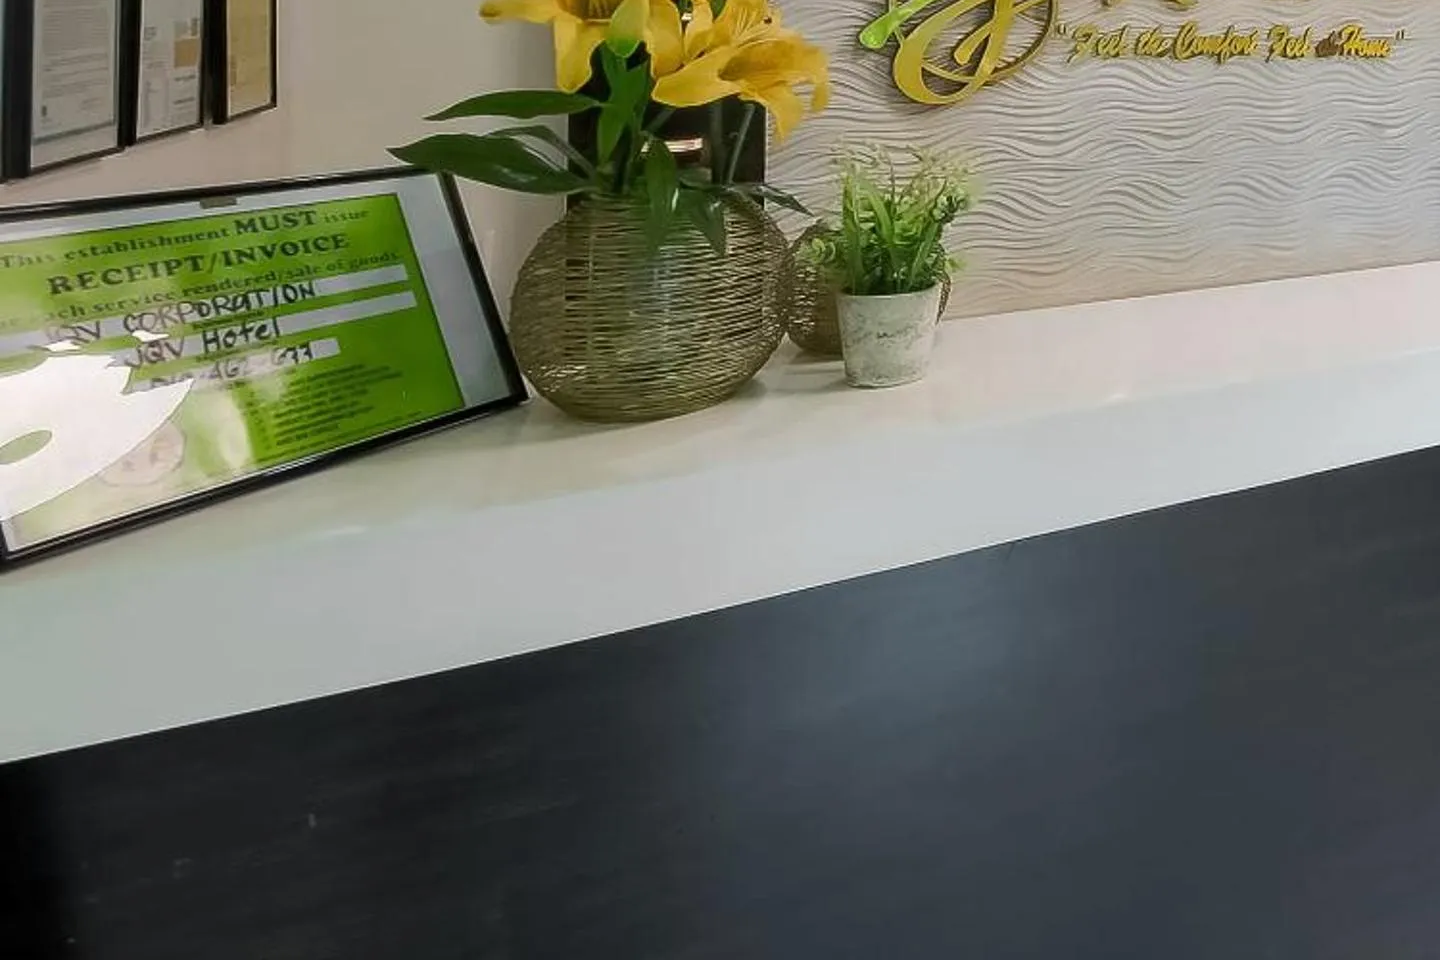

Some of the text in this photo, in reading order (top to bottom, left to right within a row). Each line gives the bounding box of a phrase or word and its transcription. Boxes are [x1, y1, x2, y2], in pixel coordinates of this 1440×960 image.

[64, 227, 230, 261] establishment
[233, 210, 317, 236] MUST
[323, 210, 369, 223] issue
[47, 232, 348, 295] RECEIPT/INVOICE
[202, 316, 280, 354] Hotel
